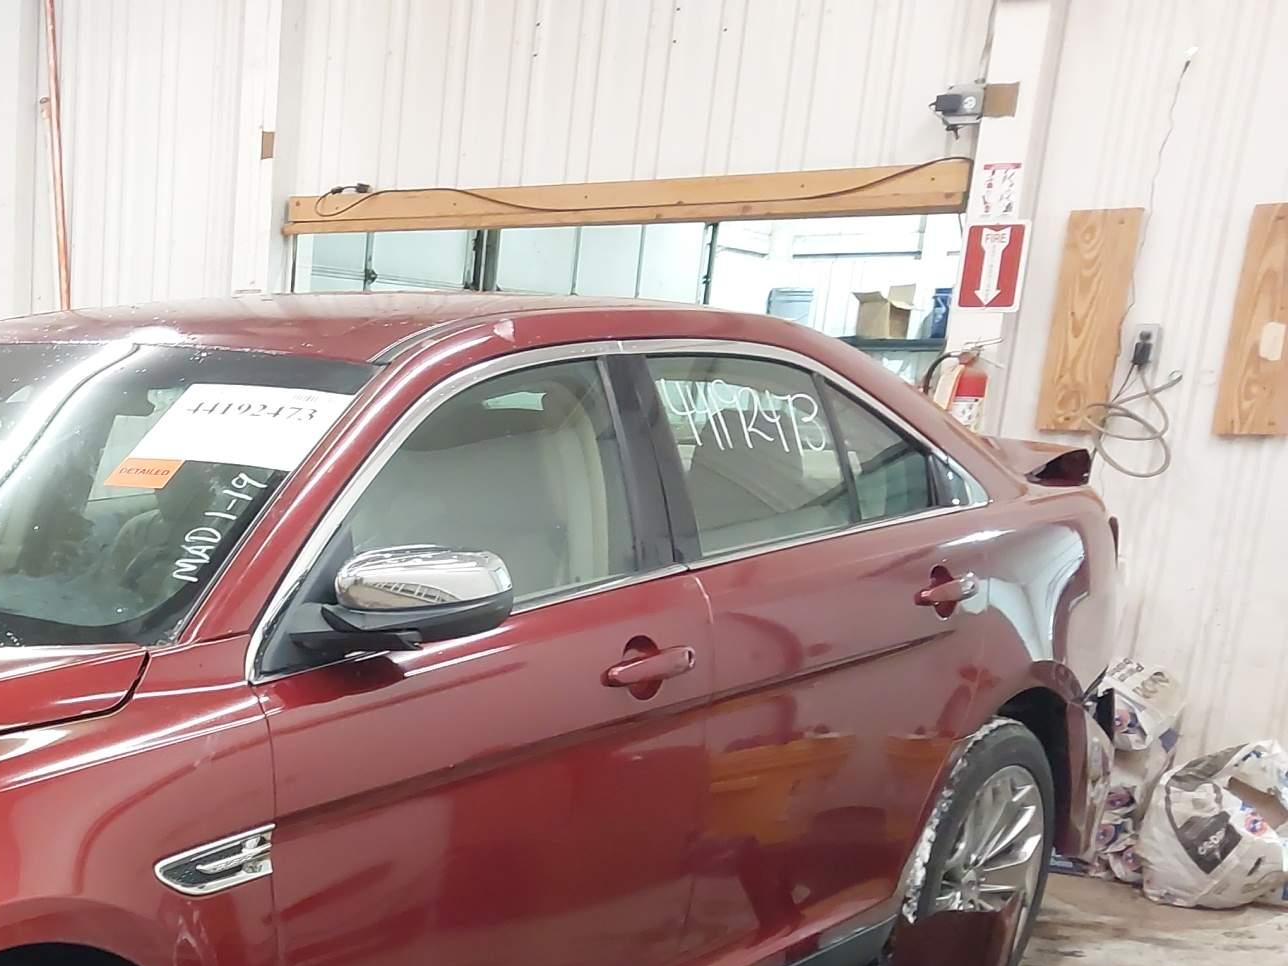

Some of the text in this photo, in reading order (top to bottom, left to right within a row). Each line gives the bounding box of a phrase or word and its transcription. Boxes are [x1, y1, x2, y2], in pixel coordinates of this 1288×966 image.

[985, 233, 1007, 243] FIRE
[187, 401, 317, 421] 44192473
[119, 467, 170, 476] DETAILED
[173, 472, 268, 582] MAD 1-19
